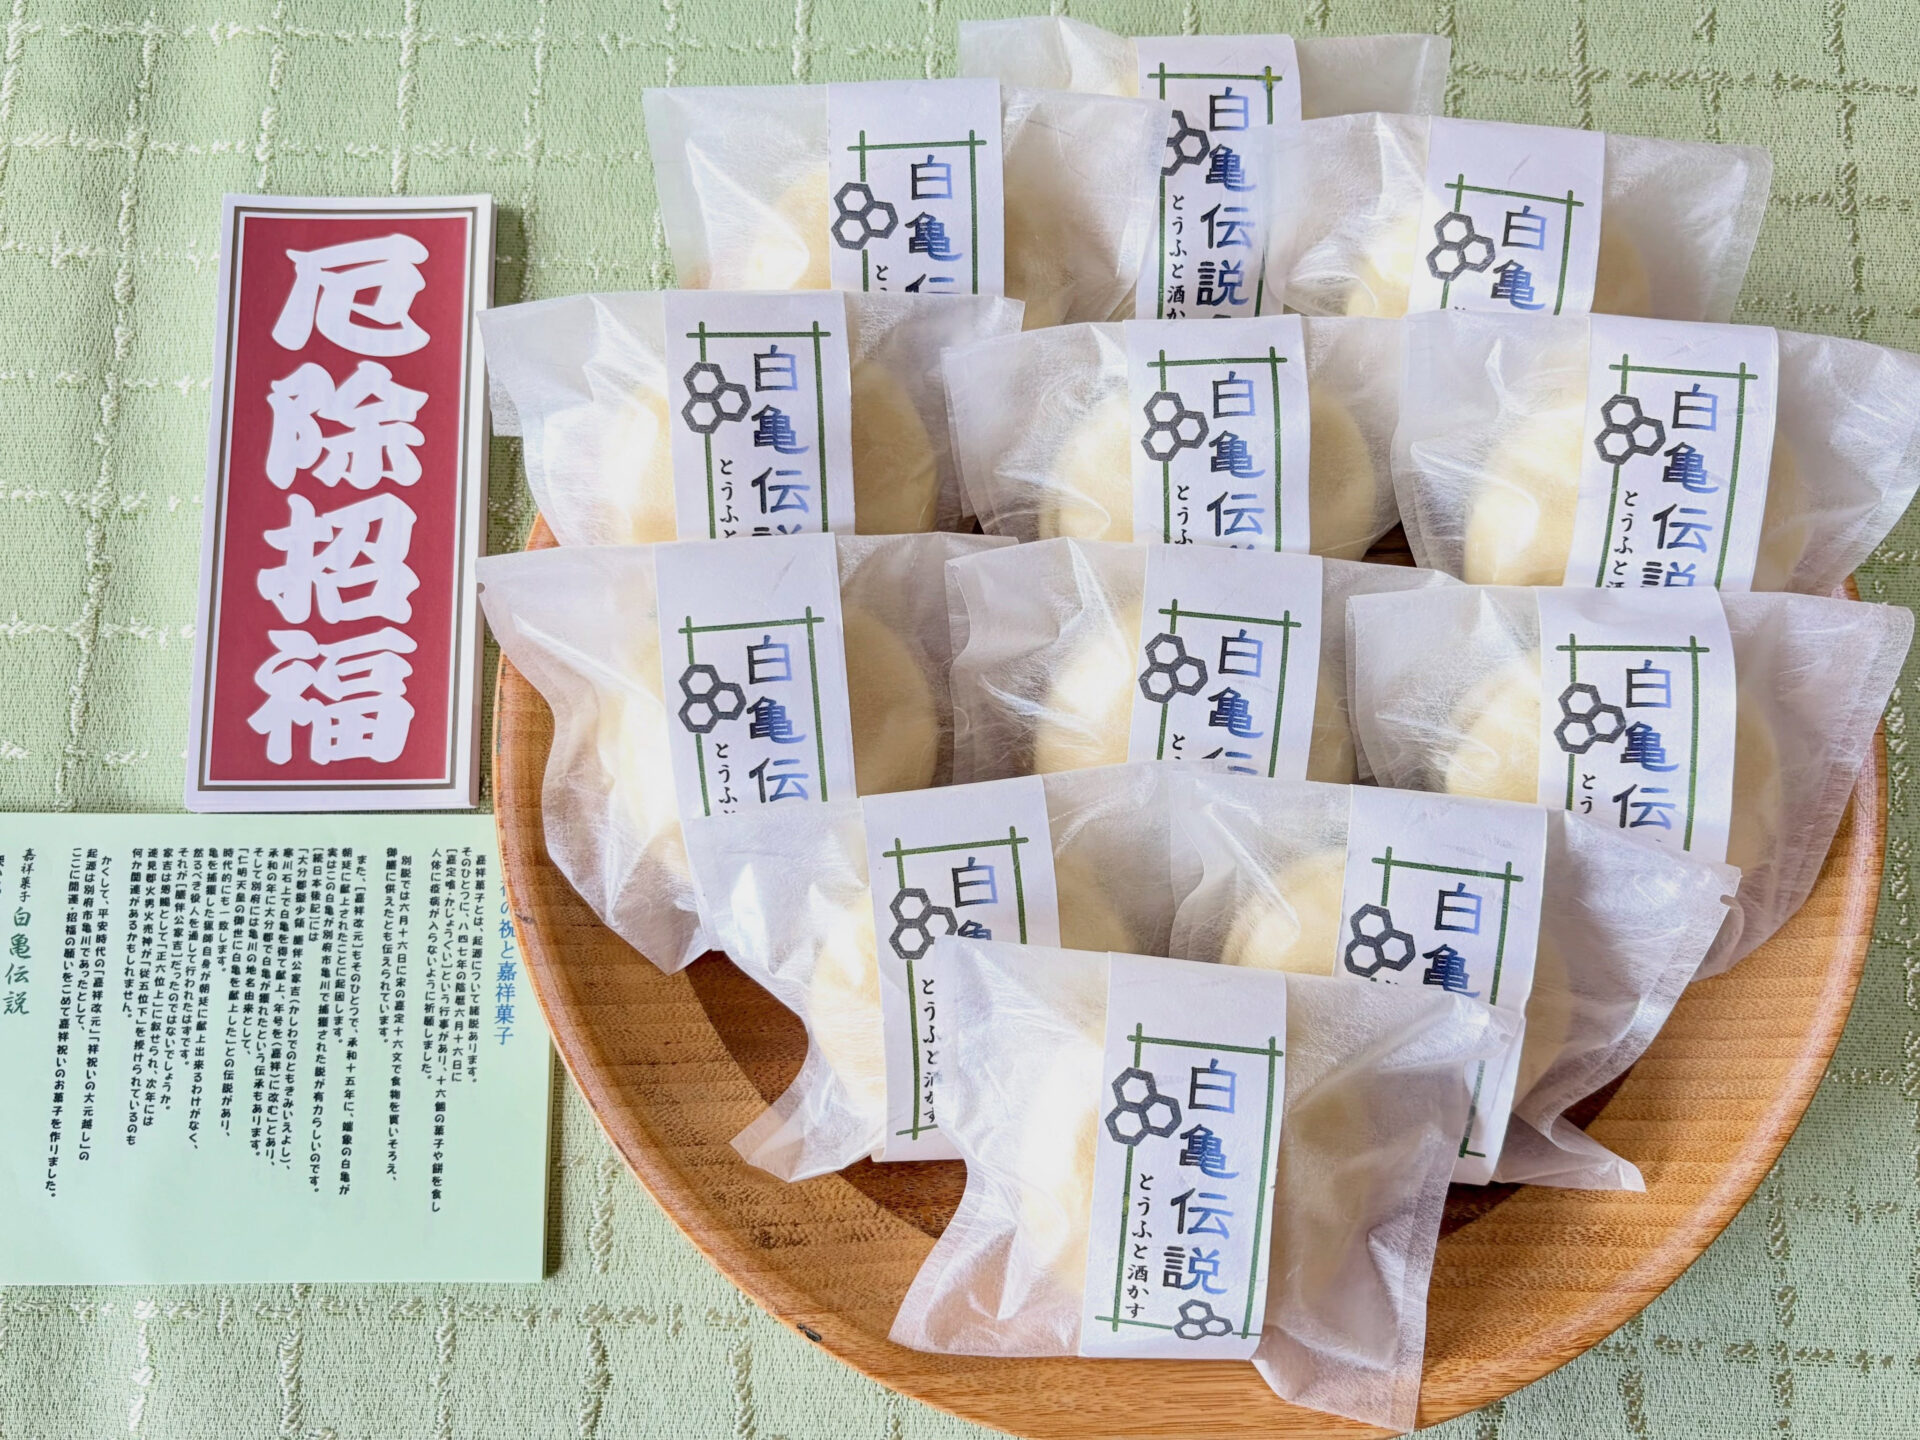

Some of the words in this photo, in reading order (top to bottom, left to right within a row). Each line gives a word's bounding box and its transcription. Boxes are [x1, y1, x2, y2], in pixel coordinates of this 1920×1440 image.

[876, 264, 889, 292] と
[1196, 86, 1257, 307] 白亀伝説
[1490, 205, 1547, 310] 白亀
[247, 233, 430, 764] 厄除招福
[1207, 371, 1266, 550] 白亀伝
[715, 743, 738, 814] とうふ
[747, 634, 809, 803] 白亀伝
[1171, 733, 1186, 760] と
[1580, 773, 1596, 814] とう
[1612, 659, 1679, 830] 白亀伝
[20, 848, 36, 902] 嘉祥菓子
[75, 848, 98, 1031] 起源は別府市亀川であったとして、
[122, 848, 143, 1018] 何か関連があるかもしれません。
[180, 848, 204, 1065] 然るべき役人を通して行われたはずです。
[217, 848, 234, 972] 時代的にも一致します。
[241, 847, 264, 1055] そして別府には亀川の地名由来として、
[333, 847, 353, 1044] 朝廷に献上されたことに起因します。
[378, 847, 398, 1044] 御膳に供えたとも伝えられています。
[1422, 882, 1482, 998] 白亀
[3, 906, 32, 1015] 白亀伝説
[494, 880, 517, 1046] の祝と嘉祥菓子
[1125, 1172, 1154, 1319] とうふと酒かす
[1163, 1058, 1239, 1295] 白亀伝説
